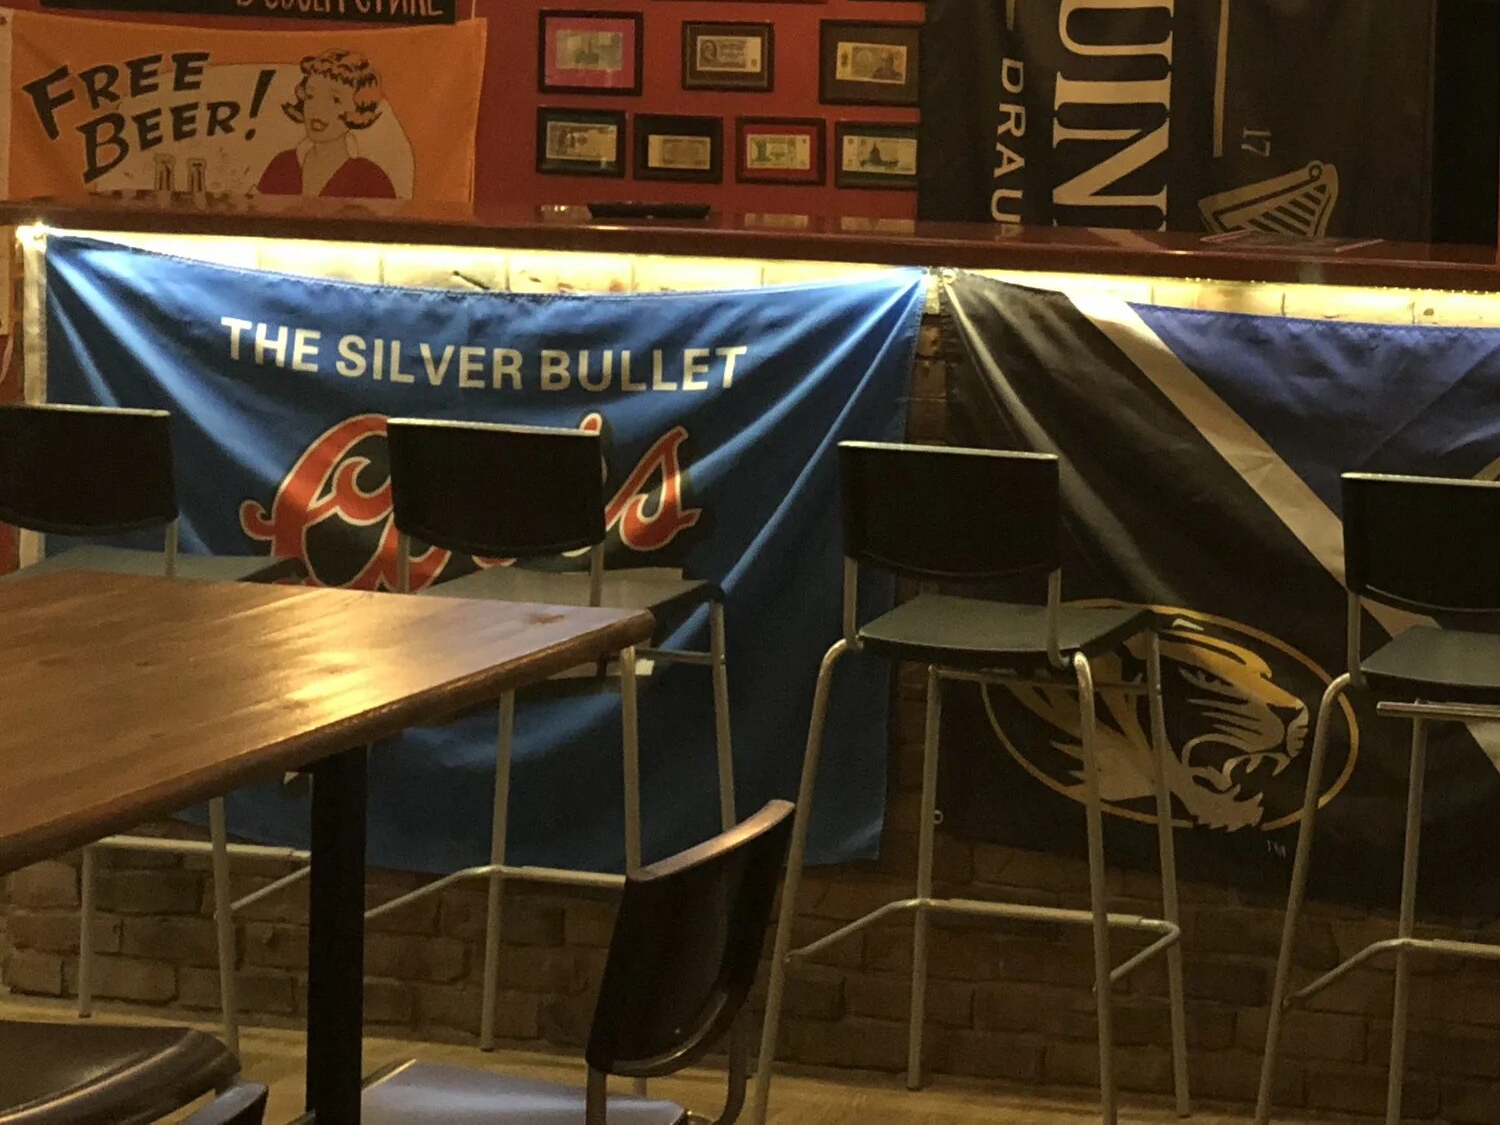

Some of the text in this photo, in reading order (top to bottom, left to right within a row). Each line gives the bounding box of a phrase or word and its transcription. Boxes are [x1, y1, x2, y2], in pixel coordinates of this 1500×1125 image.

[21, 51, 211, 141] FREE
[75, 68, 277, 185] BEER!
[220, 316, 747, 392] THE SILVER BULLET
